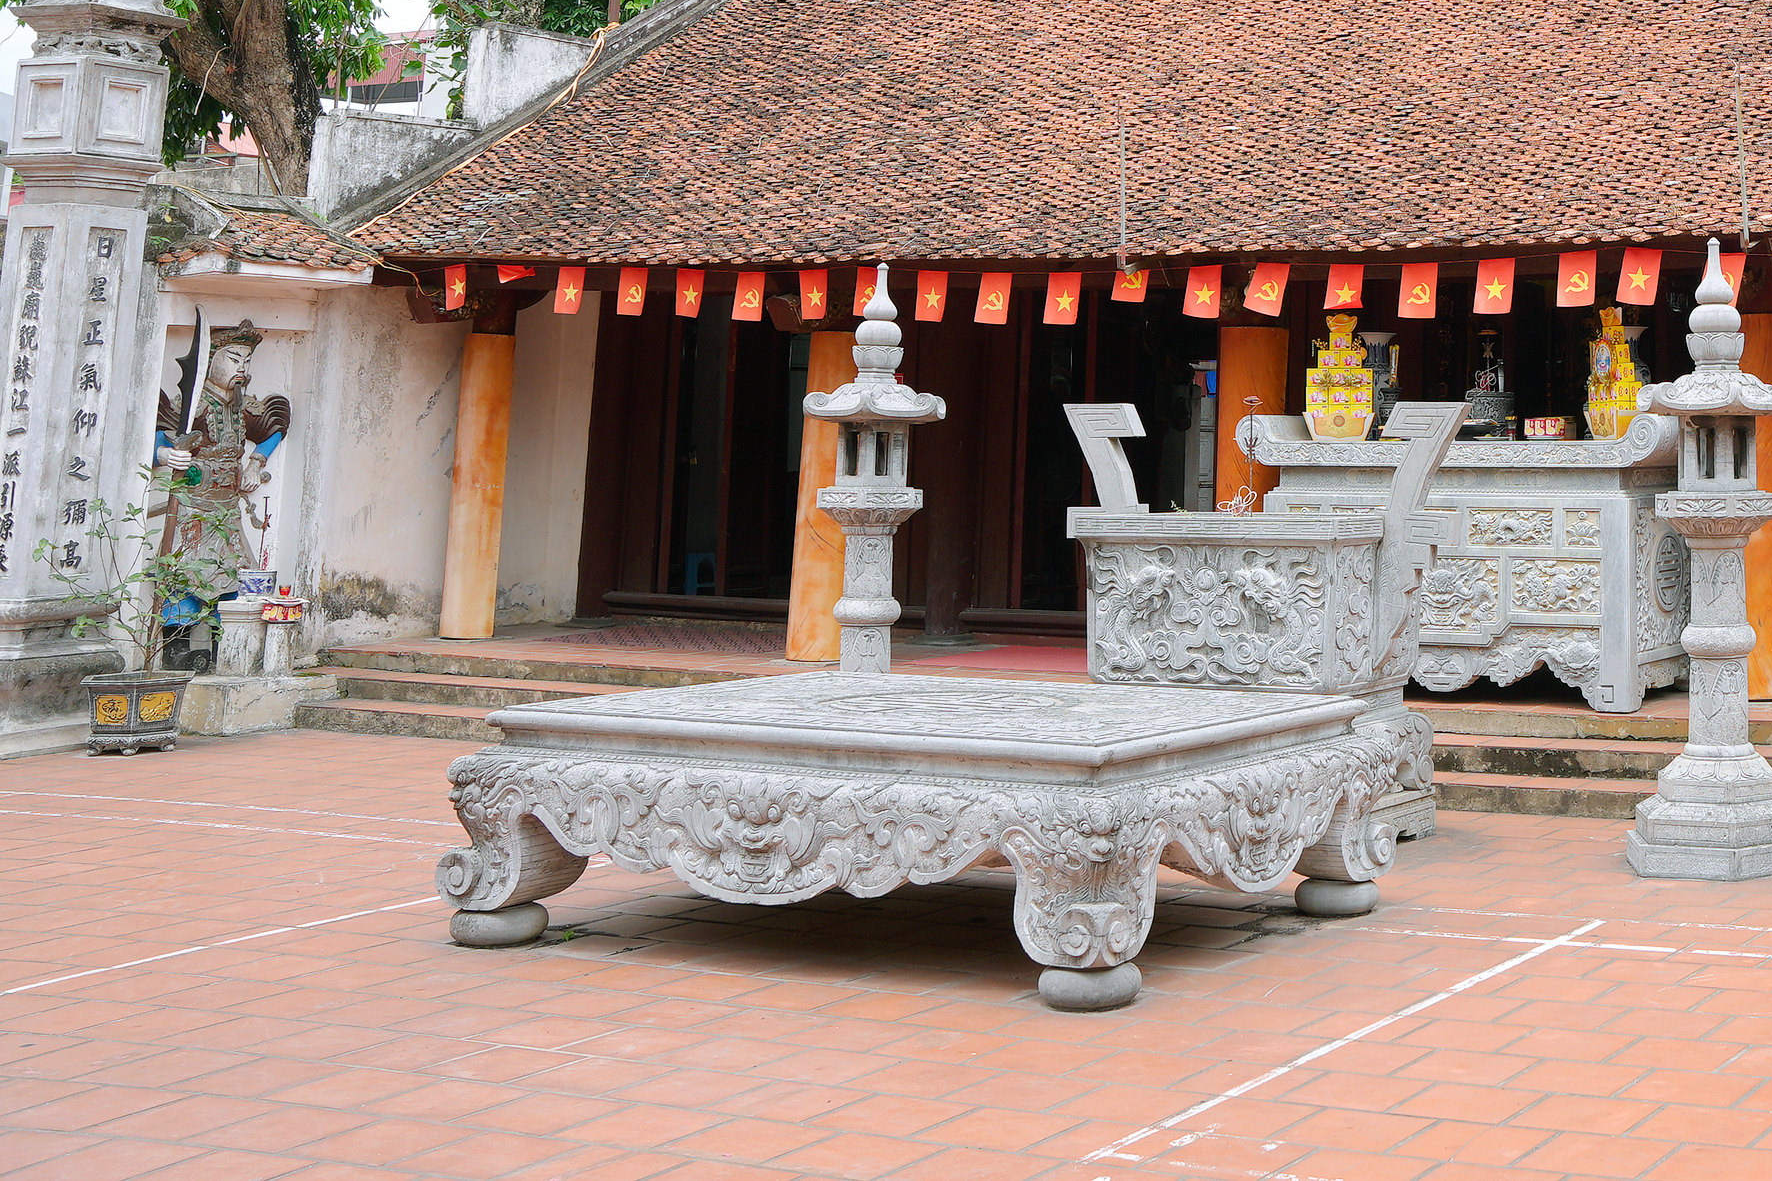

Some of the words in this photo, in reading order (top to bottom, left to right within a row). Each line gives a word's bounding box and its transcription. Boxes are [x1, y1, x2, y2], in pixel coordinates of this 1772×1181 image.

[59, 235, 114, 570] 日星正氣仰之彌高
